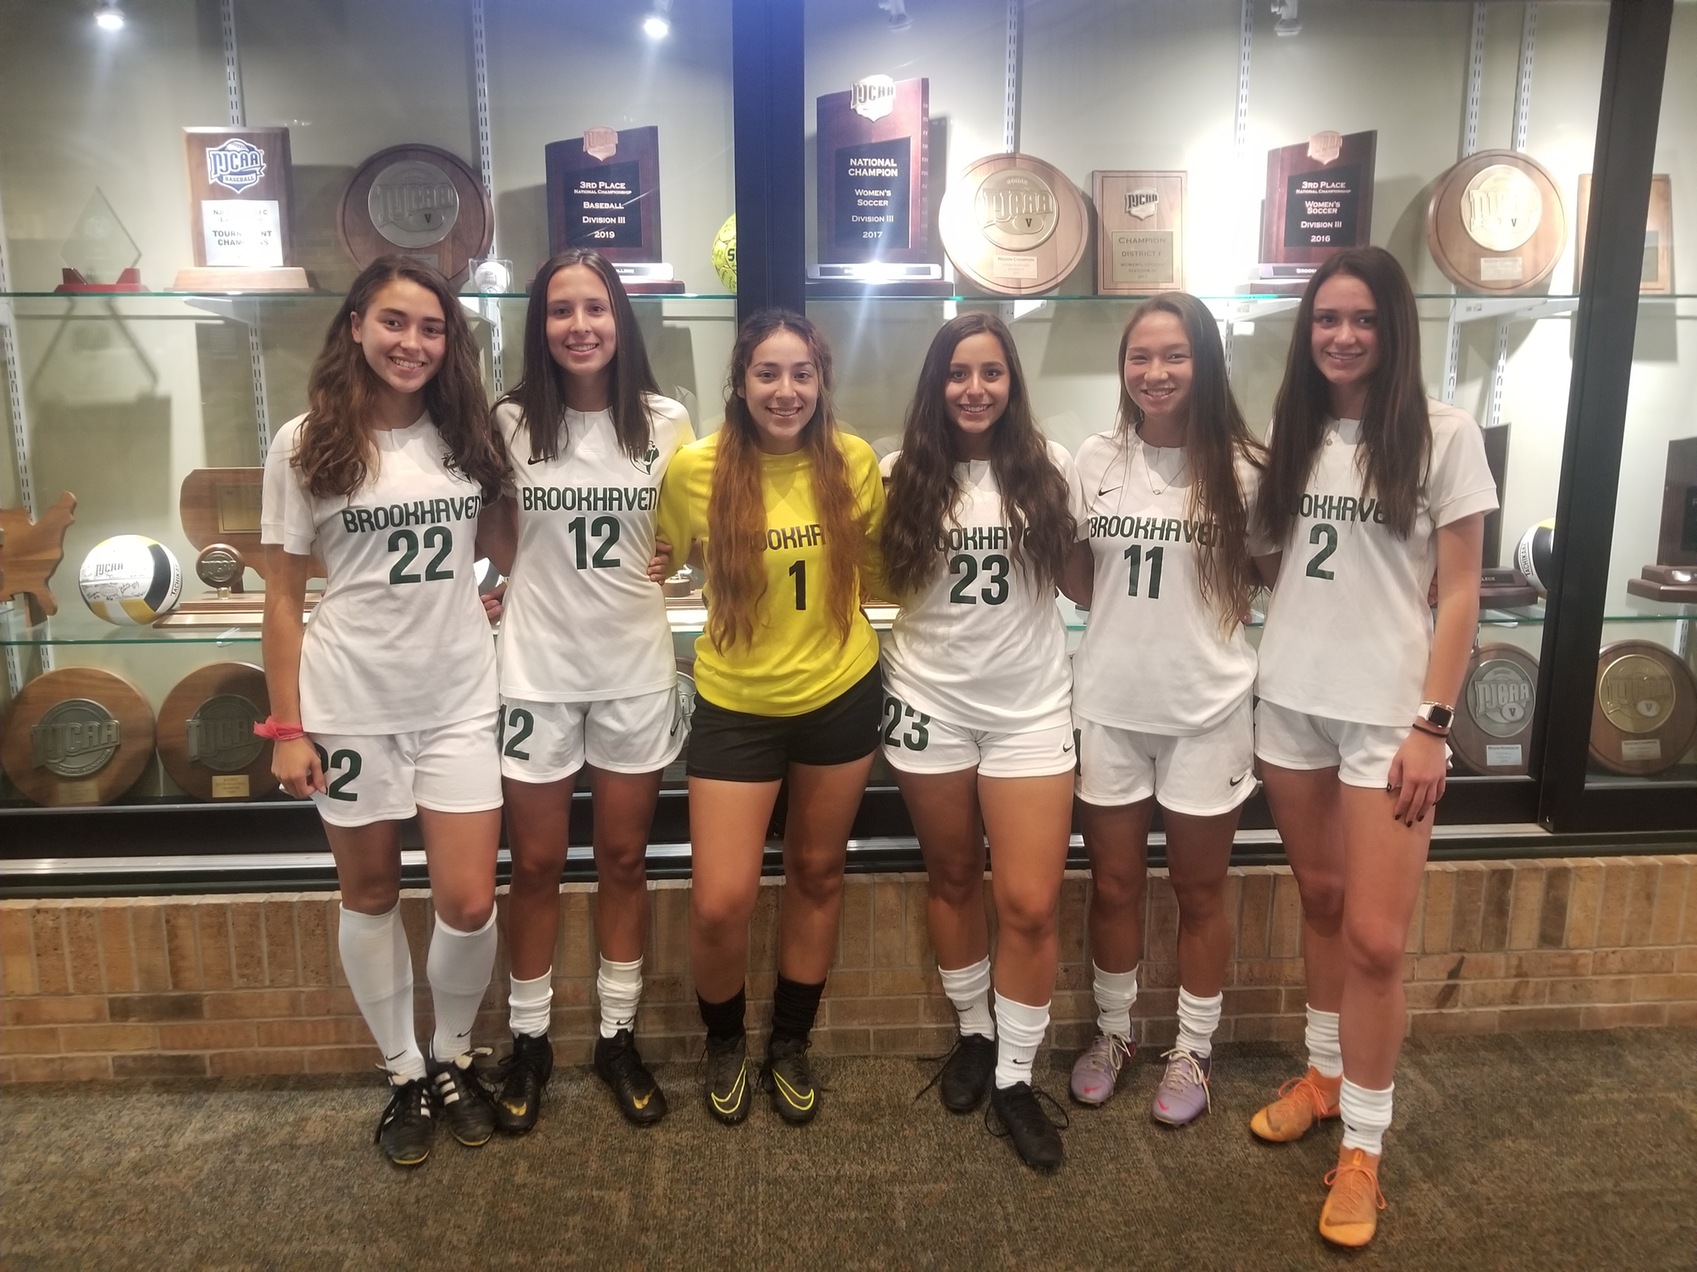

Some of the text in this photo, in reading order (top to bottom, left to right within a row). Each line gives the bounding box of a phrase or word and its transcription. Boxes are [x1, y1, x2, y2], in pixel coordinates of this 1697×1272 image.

[852, 84, 893, 106] NJCAA
[211, 153, 259, 175] NJCAA
[850, 158, 897, 167] NATIONAL
[848, 168, 898, 176] CHAMPION
[580, 181, 626, 189] 3RD PLACE
[1302, 181, 1346, 189] 3RD PLACE
[855, 189, 892, 197] WOMEN'S
[857, 199, 889, 207] SOCCER
[1128, 194, 1158, 209] NJCAA
[424, 213, 432, 223] V
[582, 216, 626, 224] DIVISION III
[1025, 218, 1032, 227] V
[594, 231, 615, 239] 2019
[862, 231, 883, 239] 2017
[1118, 236, 1166, 244] CHAMPION
[523, 487, 657, 511] BROOKHAVEN
[568, 515, 621, 570] 12
[388, 526, 454, 585] 22
[1305, 523, 1338, 580] 2
[95, 563, 124, 576] NJCAA
[1124, 544, 1164, 600] 11
[788, 560, 806, 611] 1
[950, 554, 1009, 606] 23
[1477, 683, 1530, 714] NJCAA
[1509, 707, 1516, 717] V
[884, 697, 930, 751] 23
[33, 721, 118, 767] NJCAA
